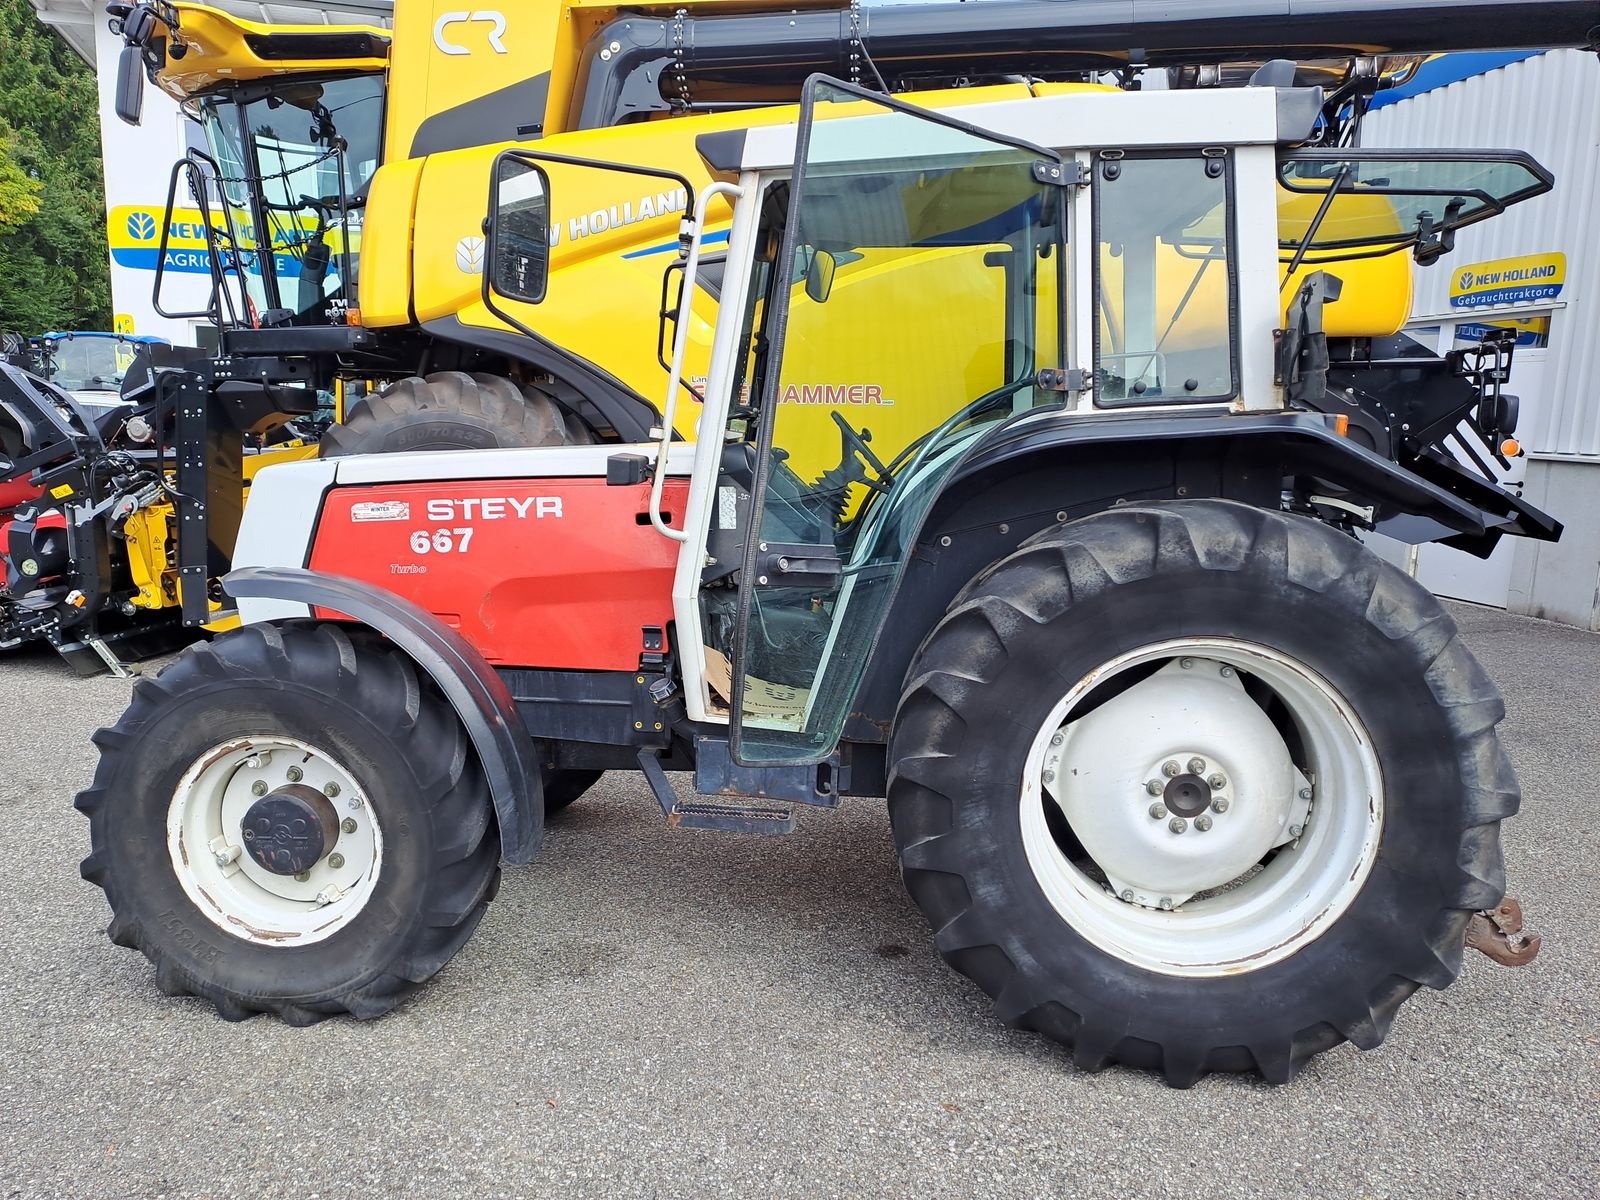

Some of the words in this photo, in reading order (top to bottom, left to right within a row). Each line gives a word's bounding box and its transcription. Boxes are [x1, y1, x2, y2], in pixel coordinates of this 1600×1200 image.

[433, 11, 508, 56] CR
[569, 187, 696, 241] HOLLAND
[1475, 273, 1501, 286] NEW
[1502, 265, 1556, 283] HOLLAND
[1456, 287, 1555, 306] Gebrauchttraktore
[427, 496, 563, 521] STEYR
[410, 527, 474, 554] 667
[390, 563, 427, 574] Turbo
